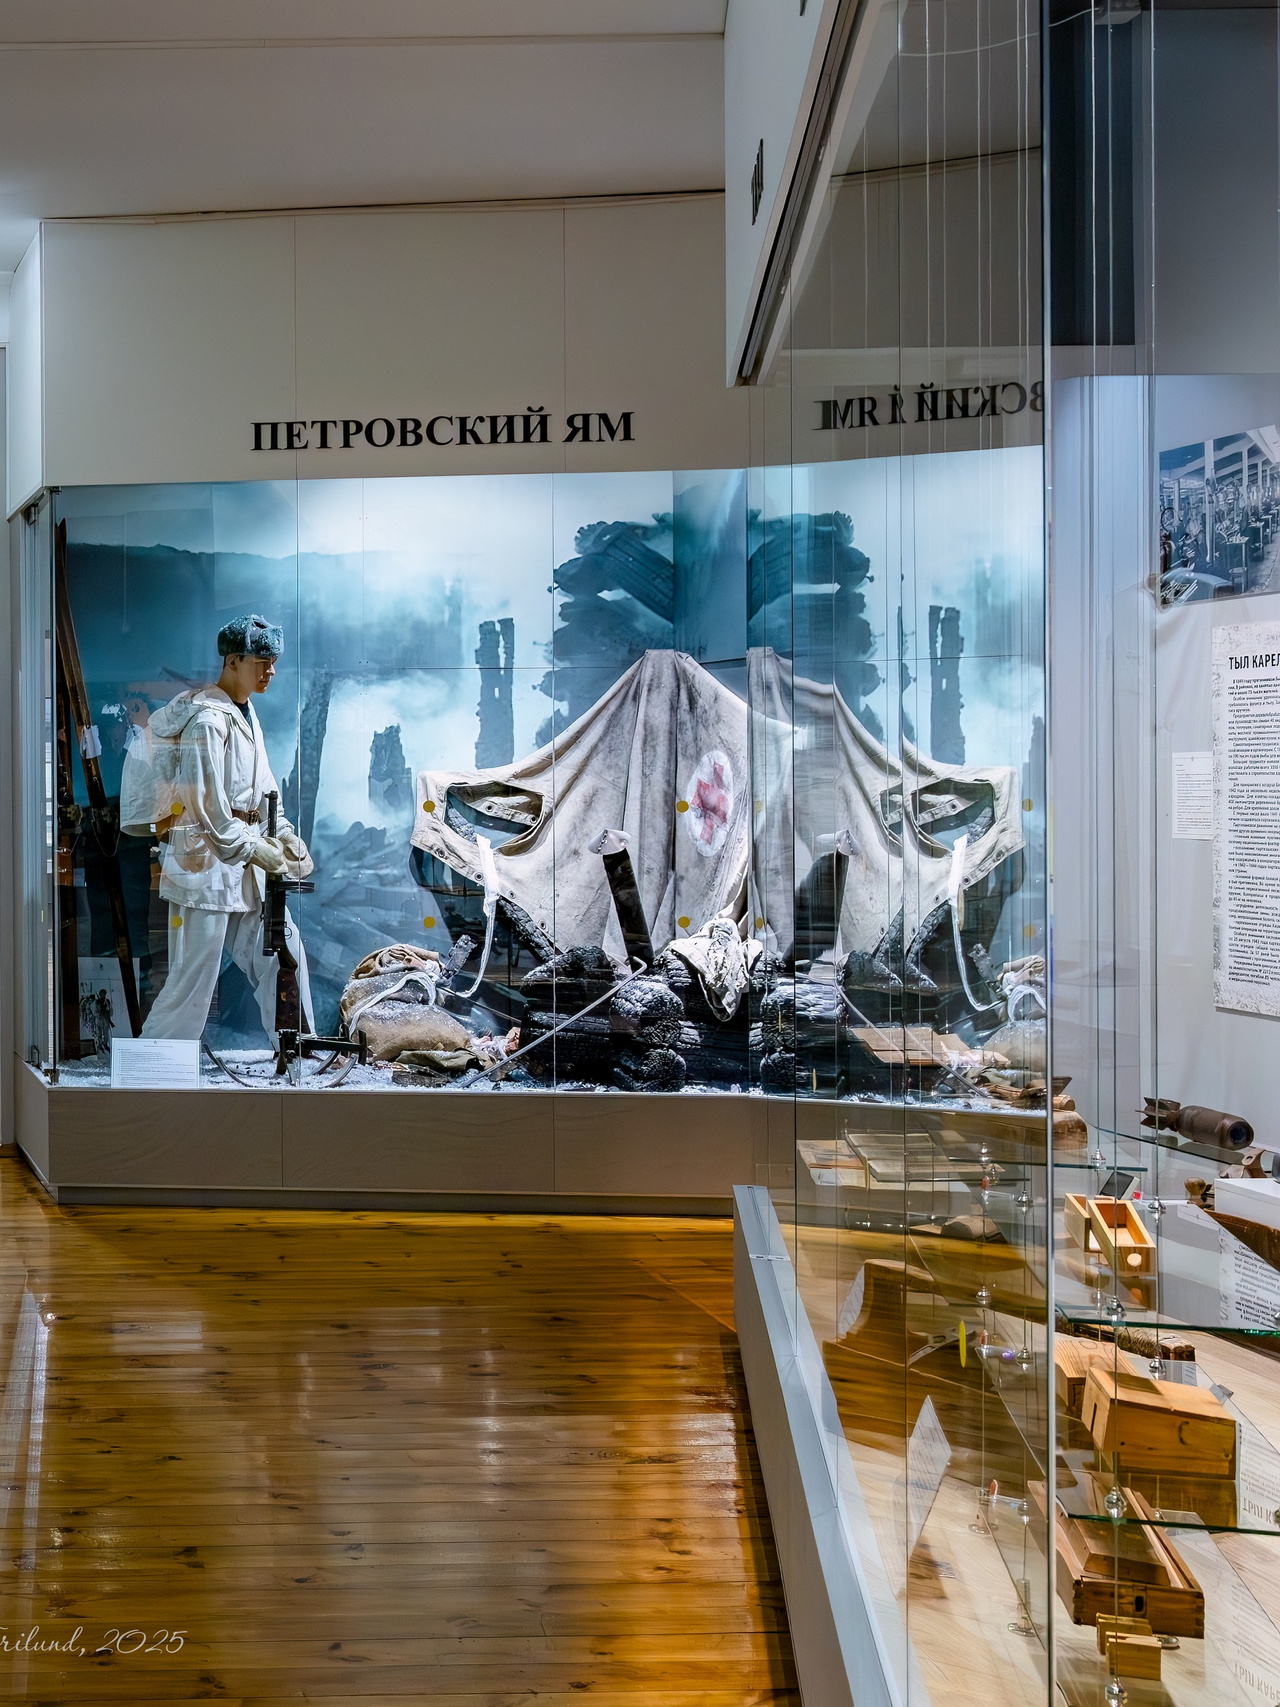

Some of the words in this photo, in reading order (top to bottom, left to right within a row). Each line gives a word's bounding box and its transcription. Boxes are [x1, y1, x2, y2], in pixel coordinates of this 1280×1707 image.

[251, 406, 552, 450] ПЕТРОВСКИЙ
[562, 412, 635, 443] ЯМ
[1229, 656, 1249, 670] ТЫЛ
